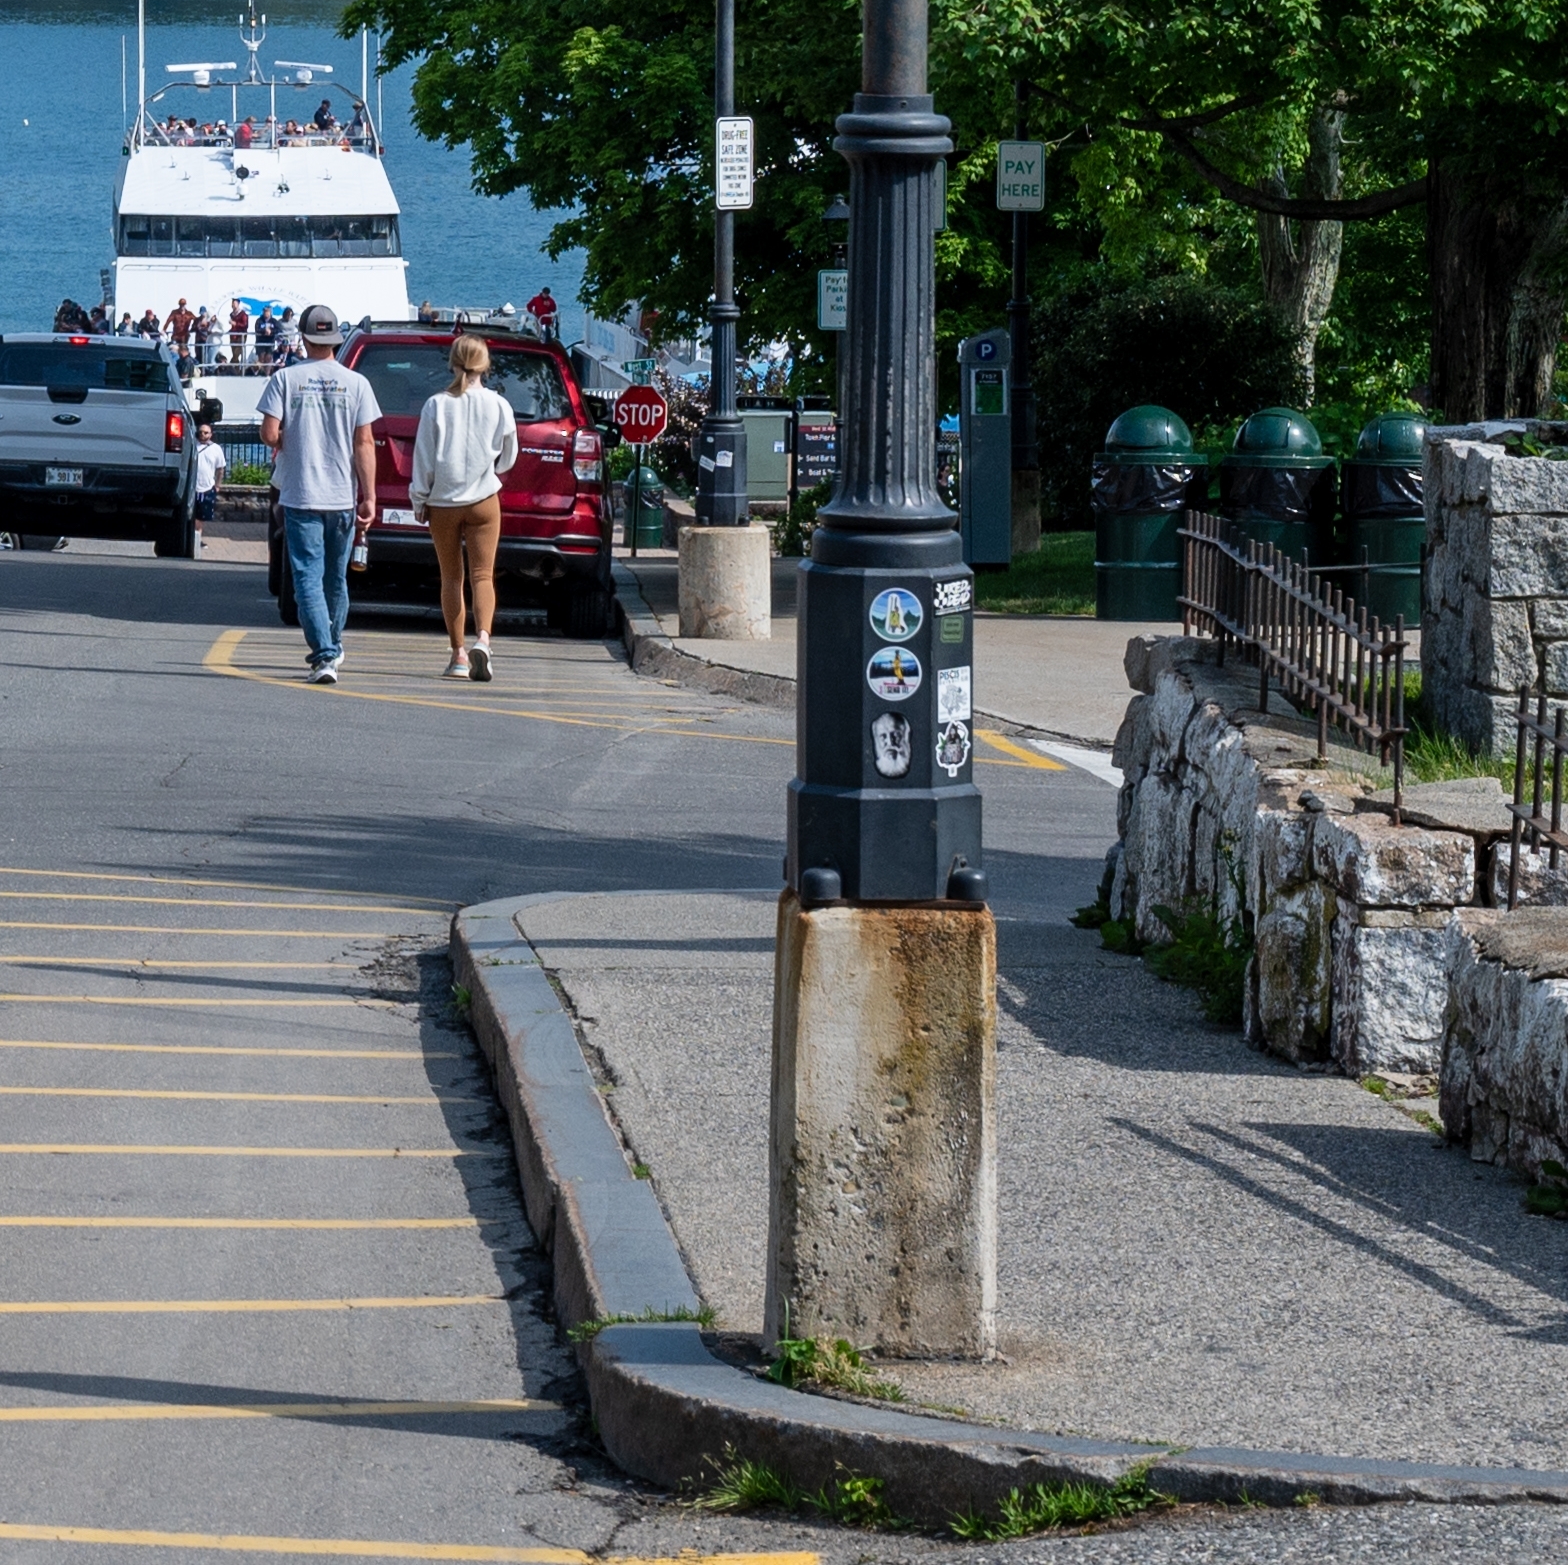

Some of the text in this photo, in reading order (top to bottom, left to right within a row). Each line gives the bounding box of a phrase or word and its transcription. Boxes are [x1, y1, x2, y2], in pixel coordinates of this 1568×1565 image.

[721, 144, 748, 155] SAFE ZONE
[1005, 161, 1036, 174] PAY
[1002, 184, 1039, 197] HERE
[826, 276, 842, 285] Pay
[617, 403, 664, 426] STOP
